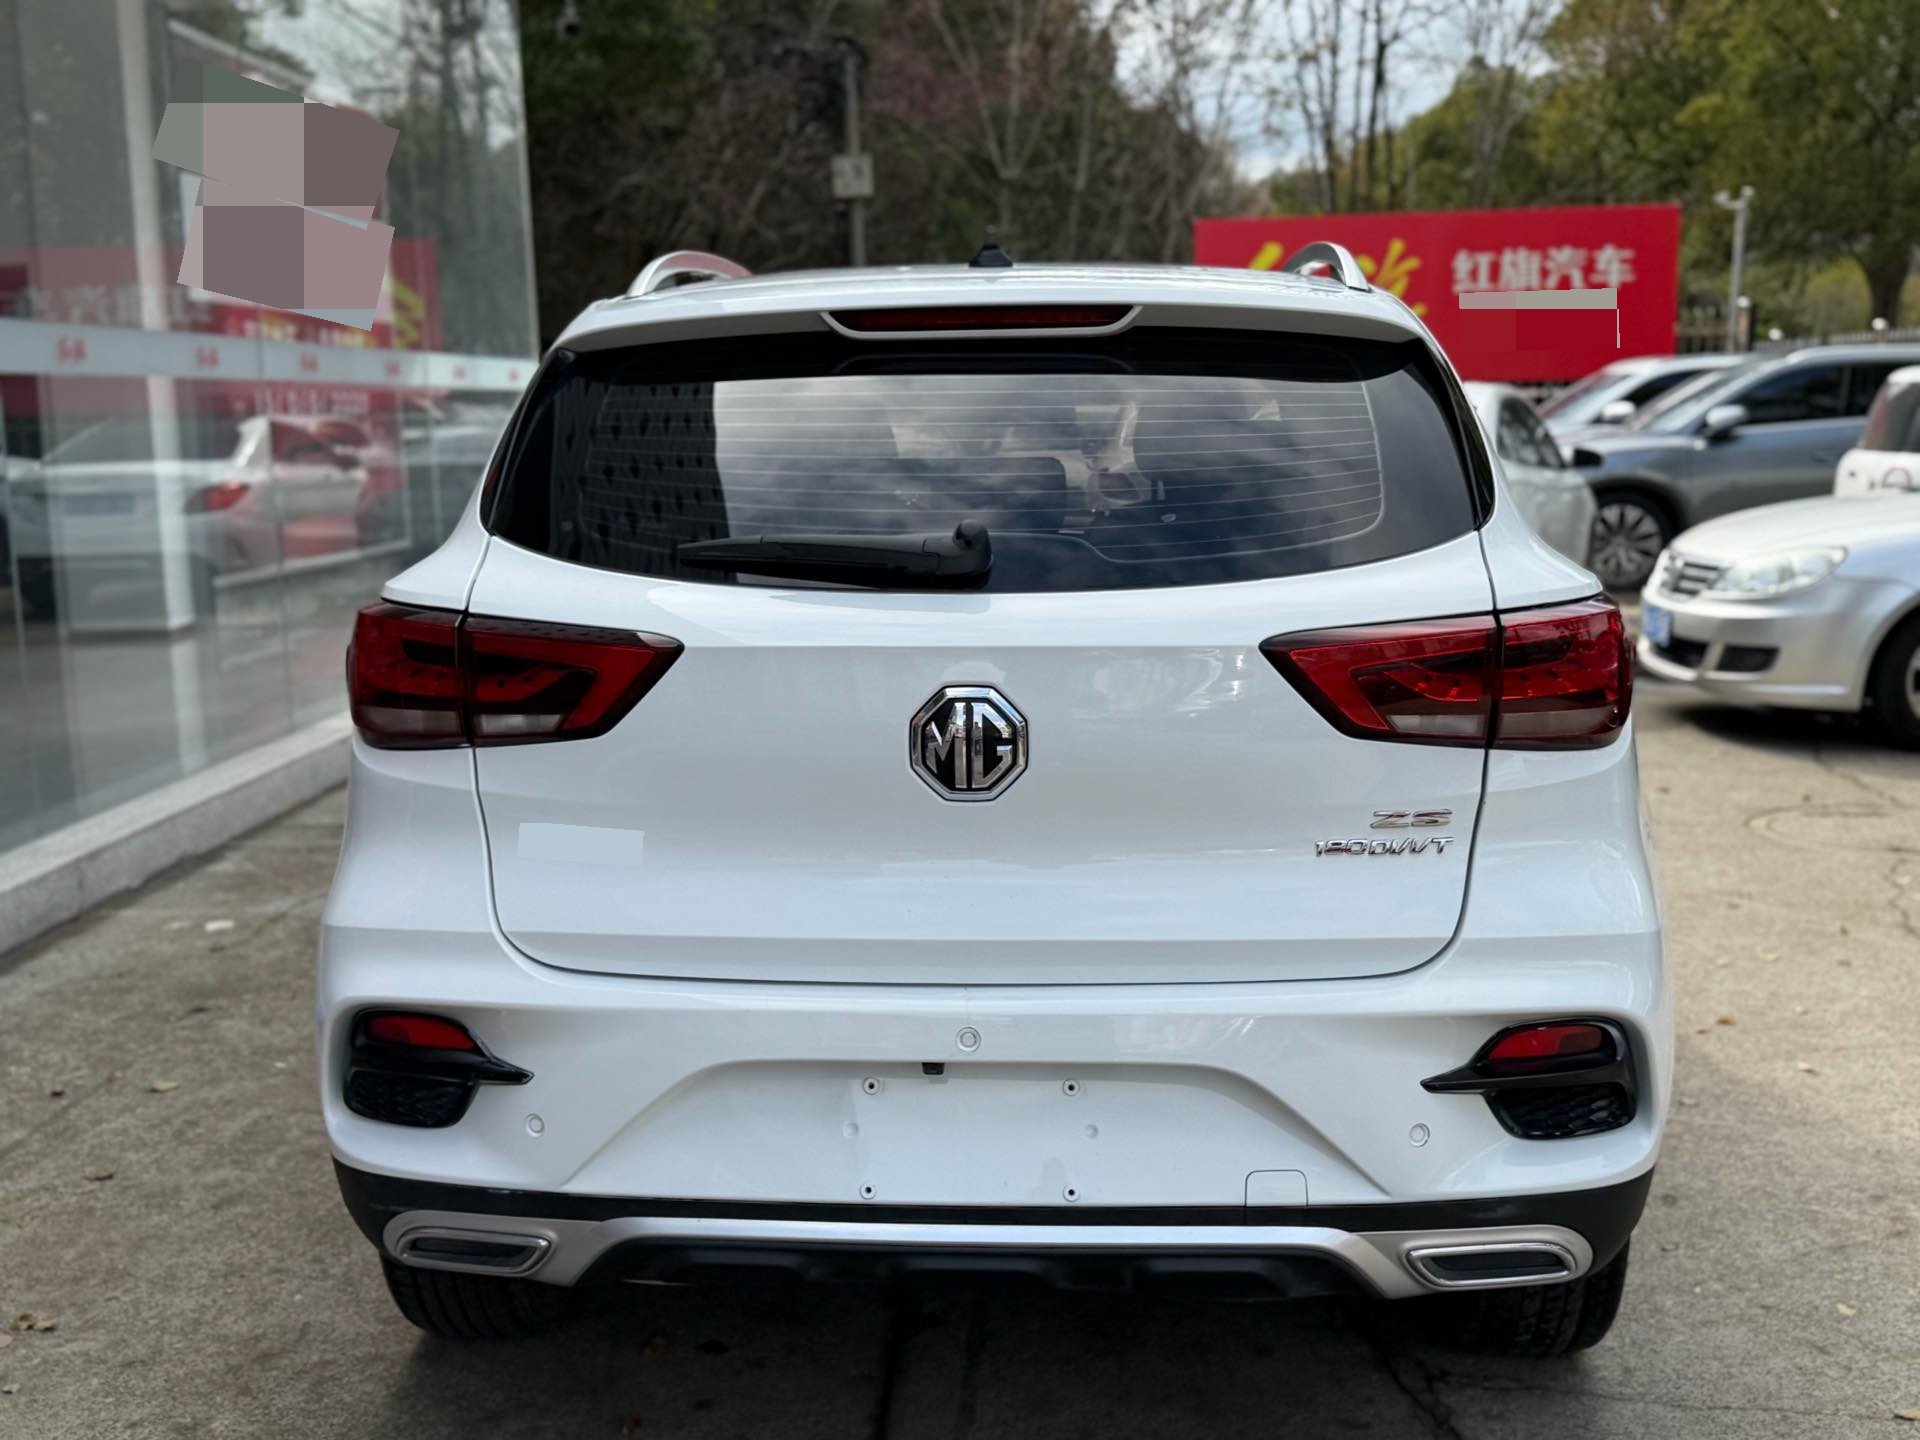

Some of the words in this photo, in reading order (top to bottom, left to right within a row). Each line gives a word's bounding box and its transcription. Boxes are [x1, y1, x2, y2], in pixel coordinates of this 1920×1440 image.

[1452, 244, 1637, 294] 红旗汽车
[924, 702, 1014, 789] MG
[1369, 809, 1453, 829] ZS
